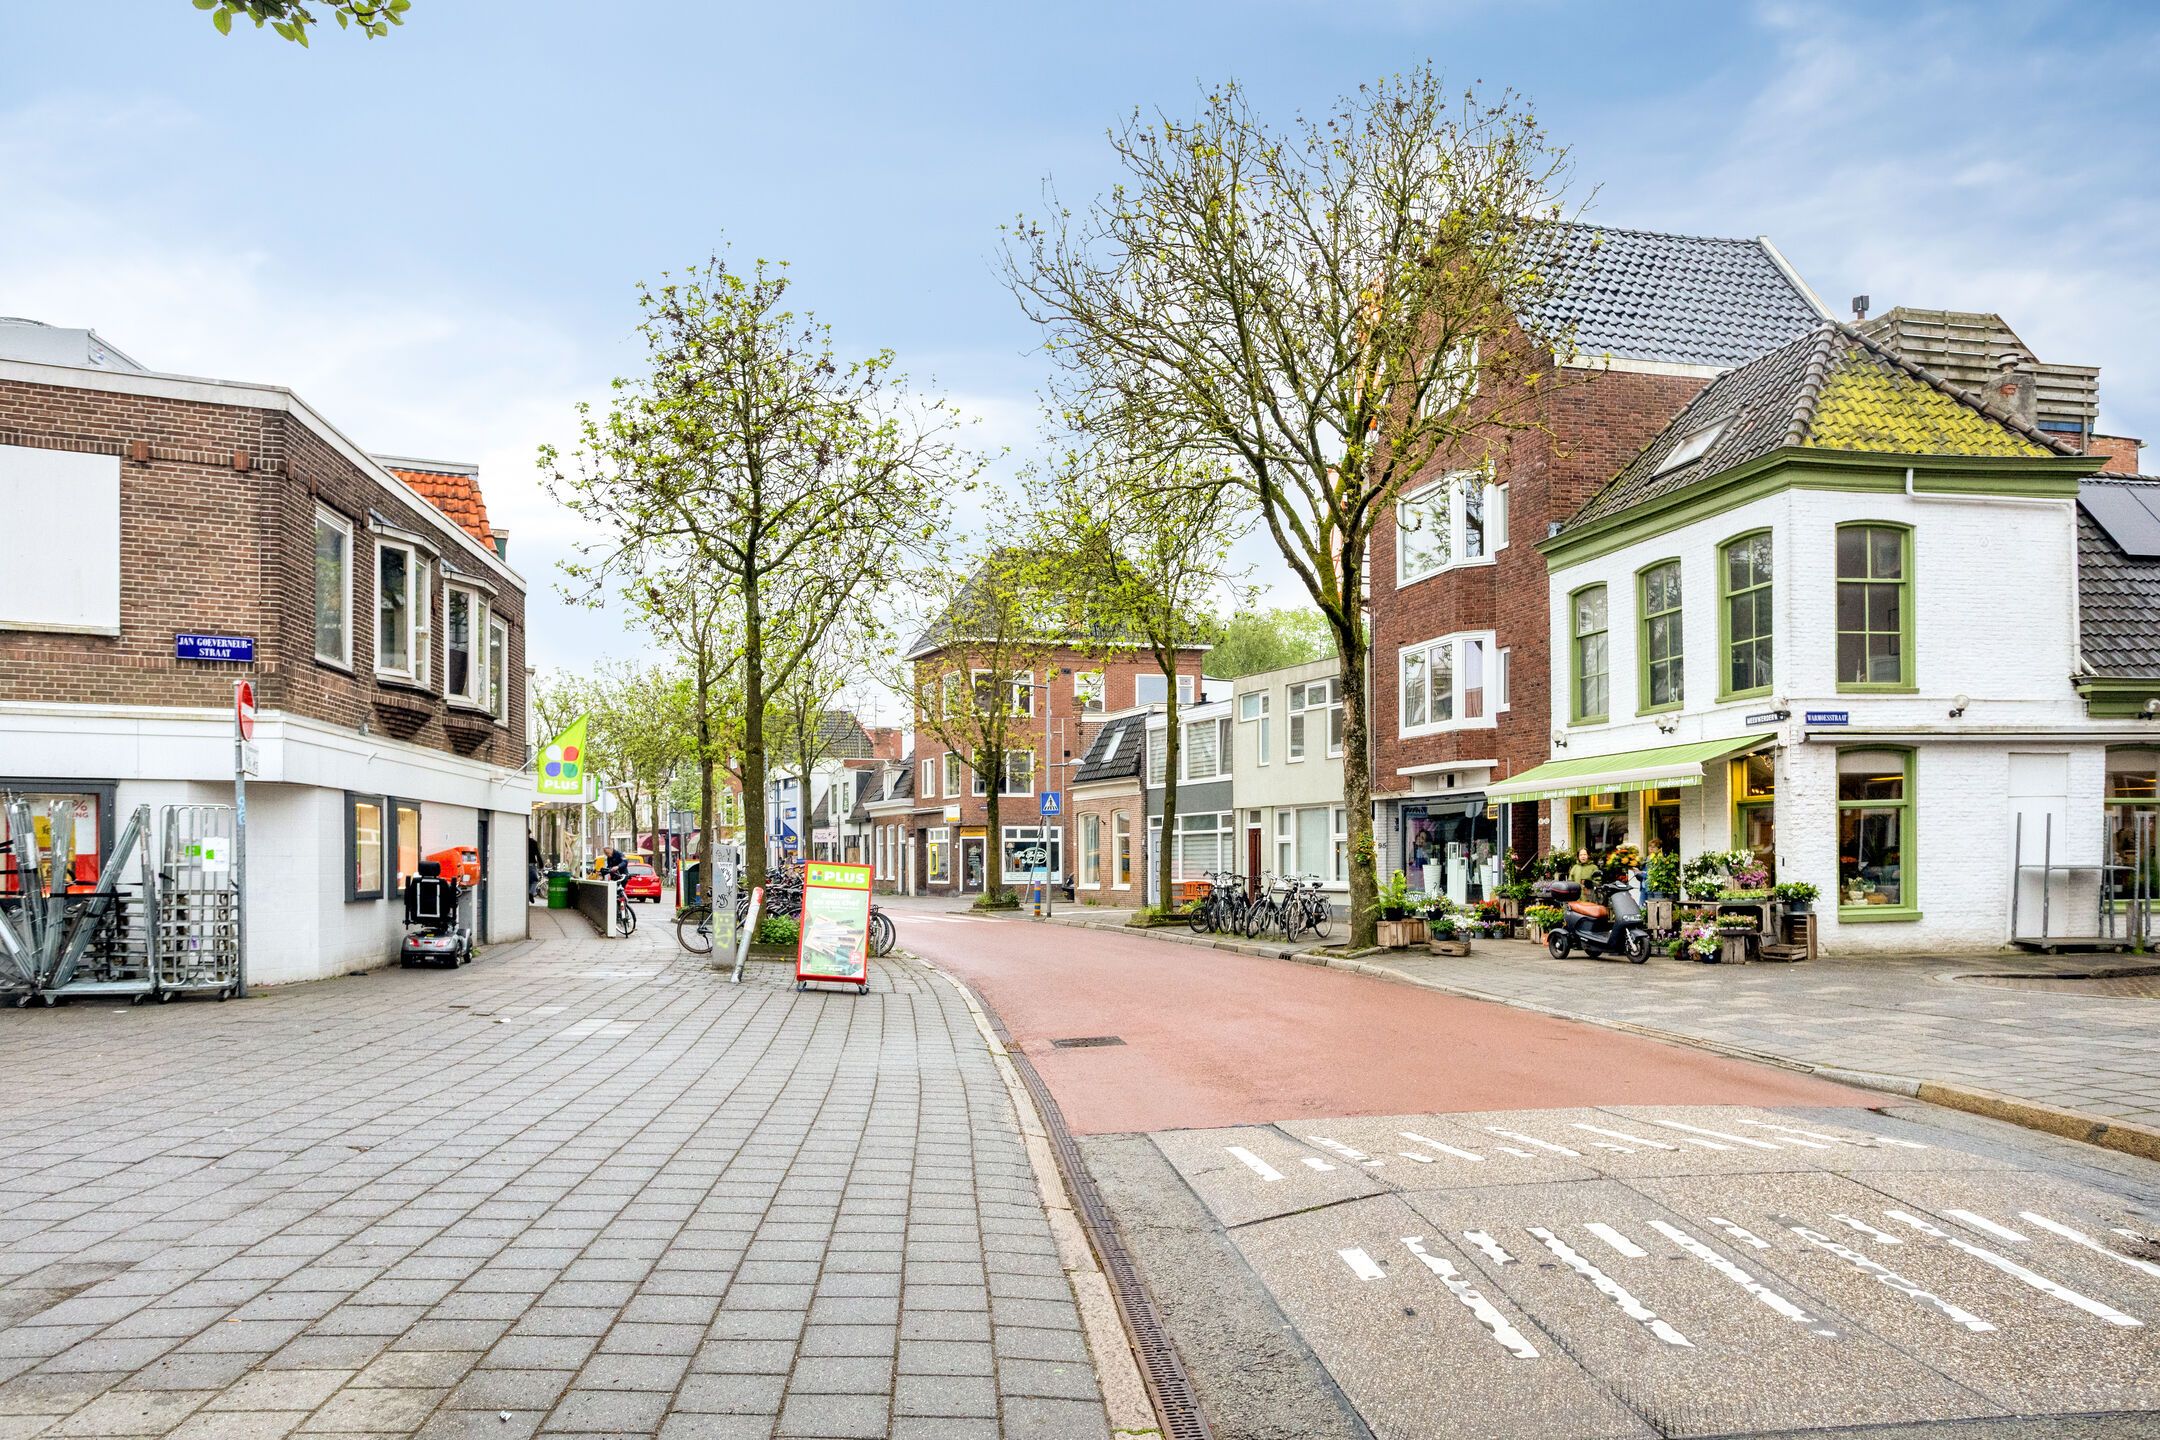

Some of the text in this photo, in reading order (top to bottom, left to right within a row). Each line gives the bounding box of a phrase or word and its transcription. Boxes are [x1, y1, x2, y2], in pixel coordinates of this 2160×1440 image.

[178, 637, 252, 648] JAN GOEVERNEUR-
[199, 648, 231, 657] STRAAT
[1807, 714, 1847, 722] WARMOESSTRAAT
[544, 779, 579, 790] PLUS
[824, 871, 865, 884] PLUS
